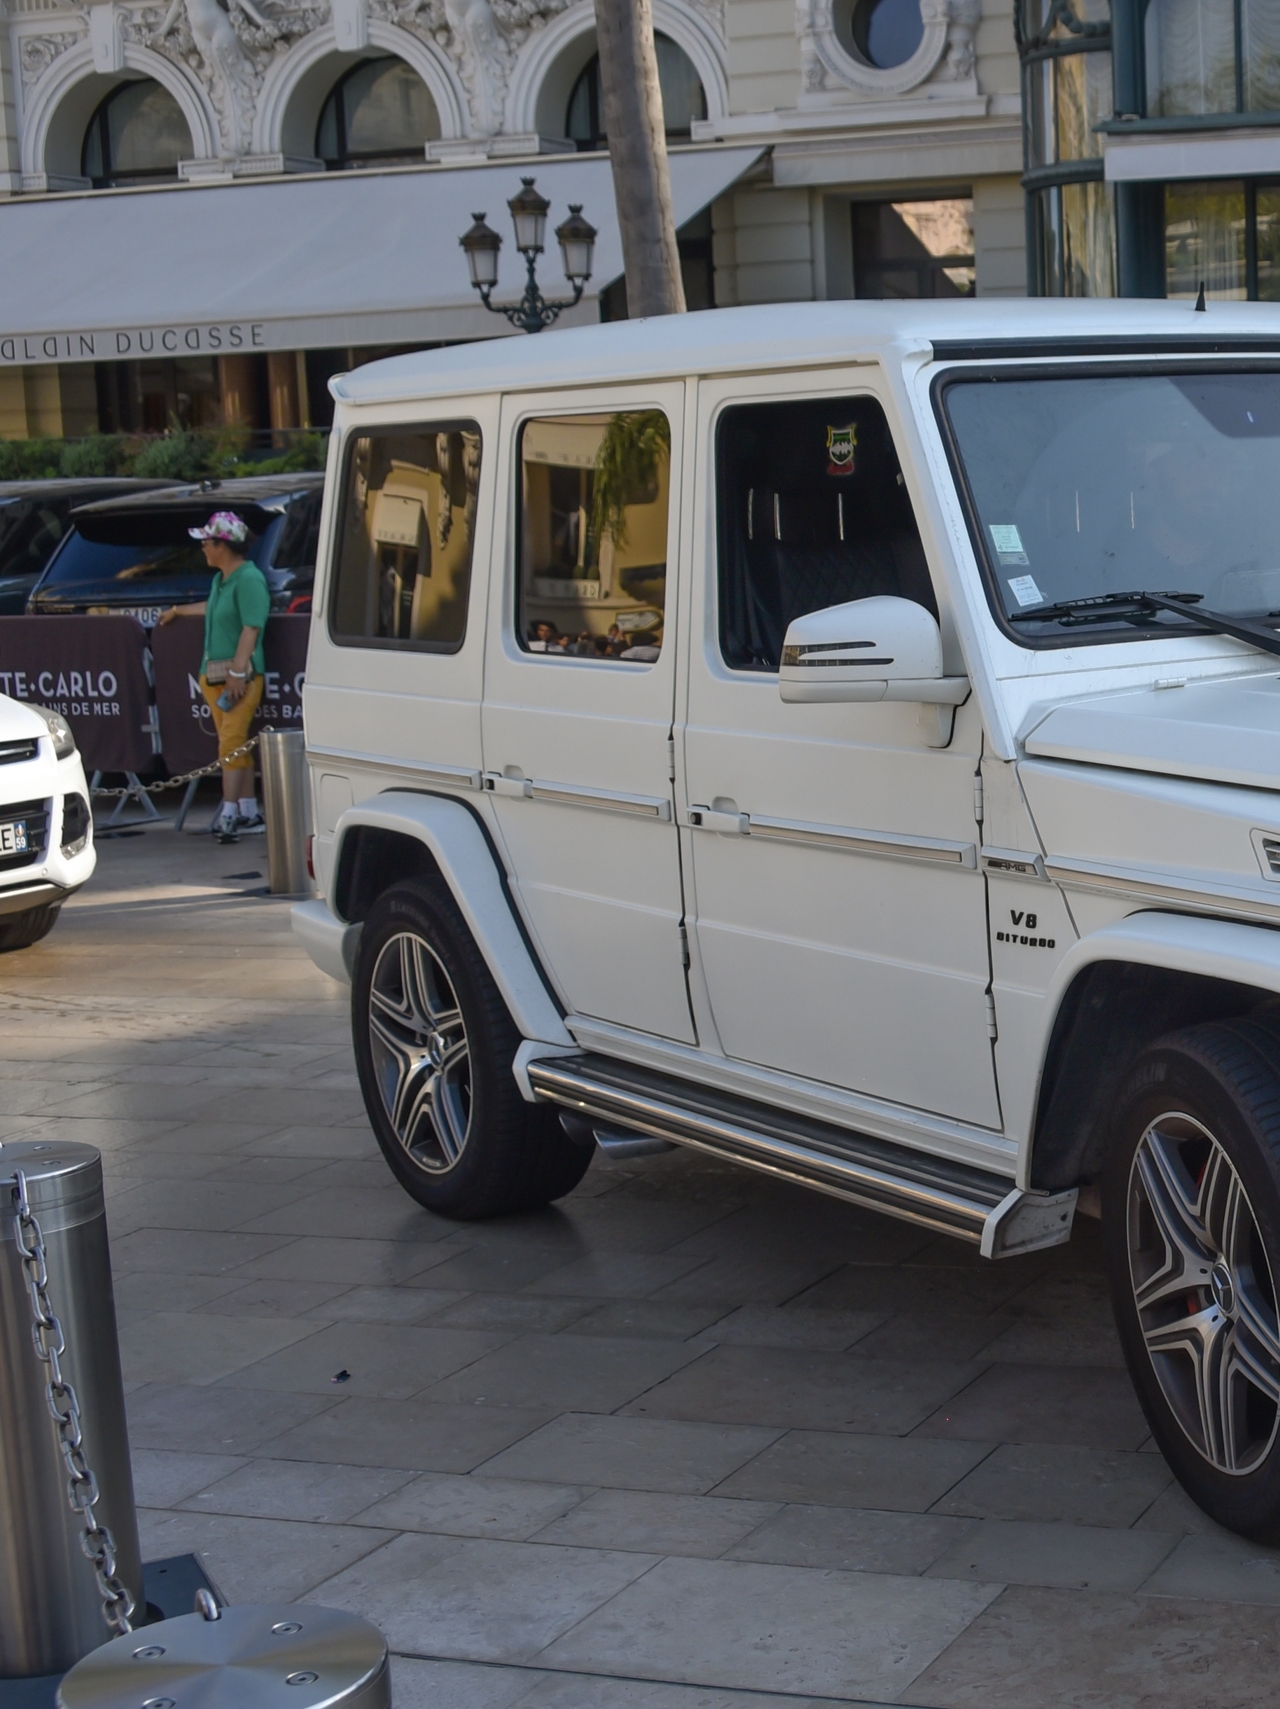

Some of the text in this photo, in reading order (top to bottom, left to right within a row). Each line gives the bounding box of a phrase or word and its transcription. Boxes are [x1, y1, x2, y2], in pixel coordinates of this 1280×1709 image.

[116, 324, 265, 353] DUCASSE
[72, 702, 90, 716] DE
[94, 702, 120, 716] MER
[1000, 861, 1027, 873] AMG
[1010, 909, 1037, 929] V8
[996, 931, 1056, 949] BITURBO
